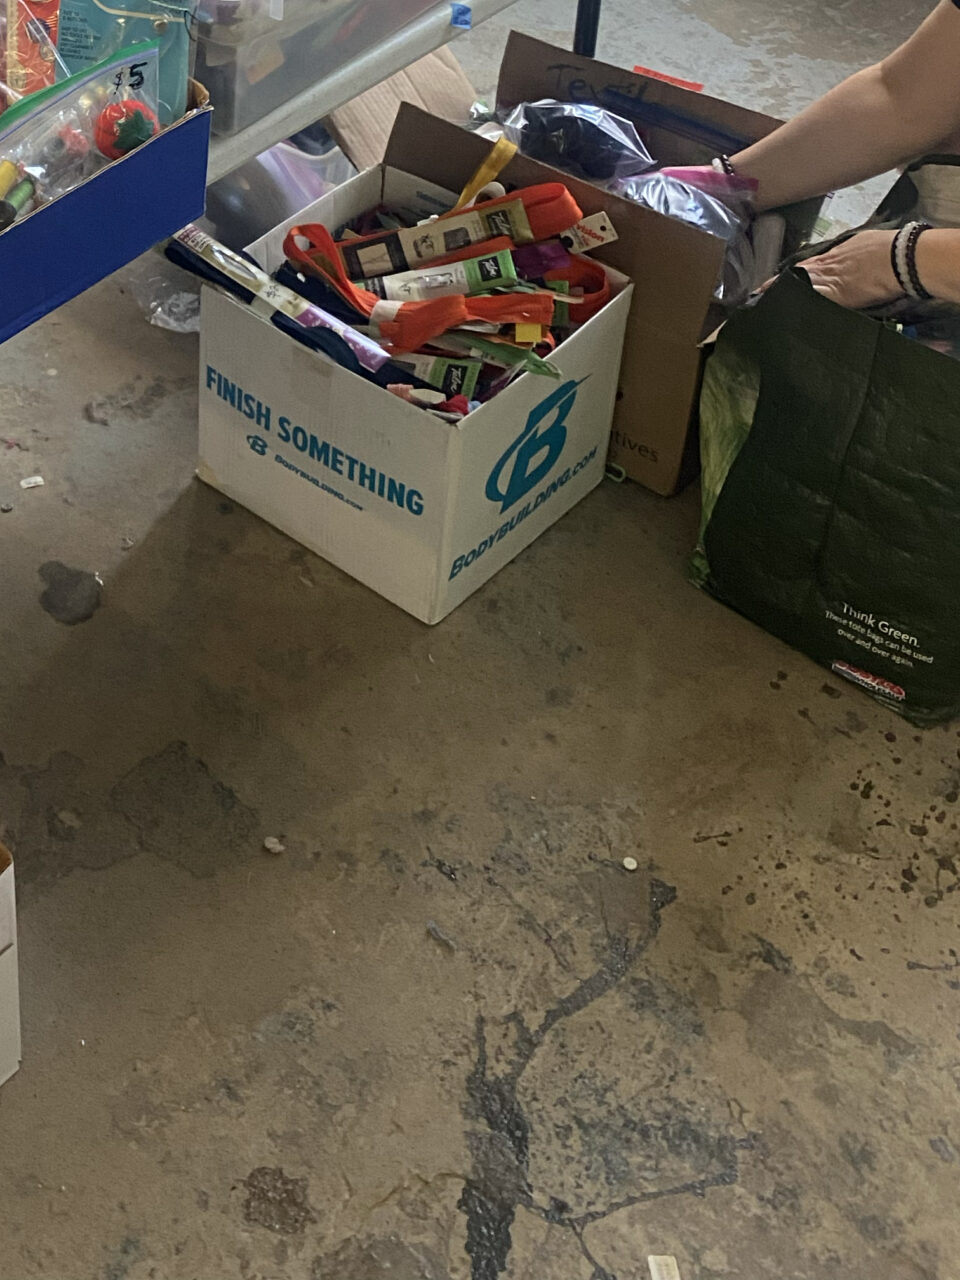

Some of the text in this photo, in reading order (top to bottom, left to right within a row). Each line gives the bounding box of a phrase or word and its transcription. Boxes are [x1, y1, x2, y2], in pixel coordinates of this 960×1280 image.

[111, 61, 149, 95] $5
[206, 365, 424, 516] FINISH SOMETHING
[825, 610, 934, 664] These tote bags can be used
[837, 628, 856, 641] over
[855, 639, 872, 650] and
[871, 646, 890, 658] over
[842, 601, 920, 648] Think Green.
